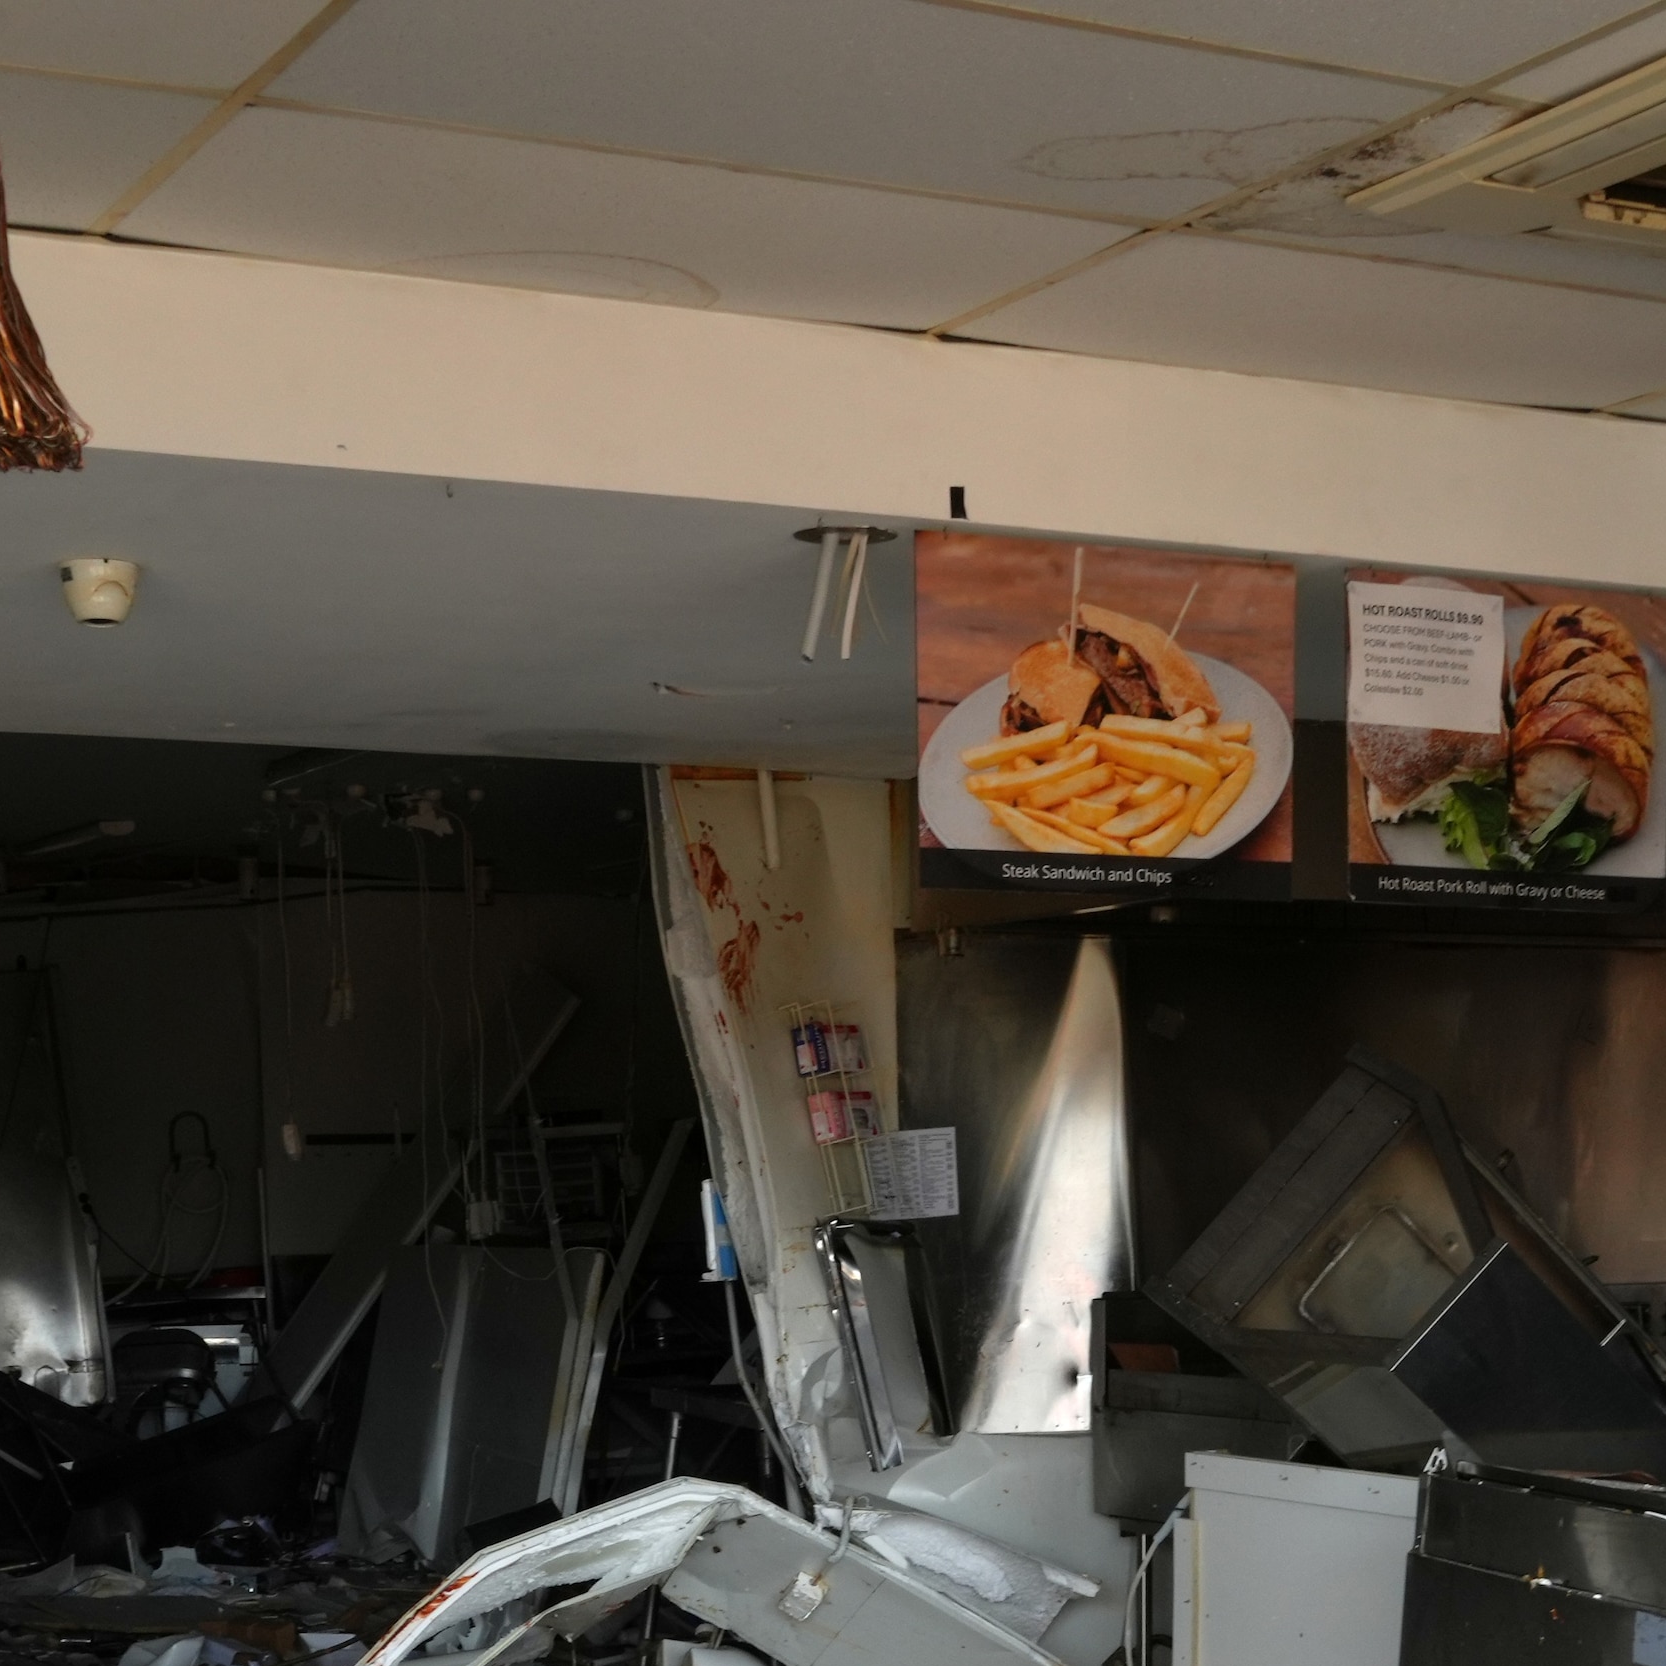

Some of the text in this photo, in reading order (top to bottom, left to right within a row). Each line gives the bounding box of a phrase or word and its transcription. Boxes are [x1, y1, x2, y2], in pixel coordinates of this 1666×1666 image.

[1363, 605, 1484, 625] HOT ROAST ROLLS $9.90
[1363, 623, 1401, 634] CHOOSE
[1403, 626, 1426, 636] FROM
[1002, 863, 1172, 886] Steak Sandwich and Chips
[1378, 877, 1605, 901] Hot Roast Pork Roll with Gravy or Cheese
